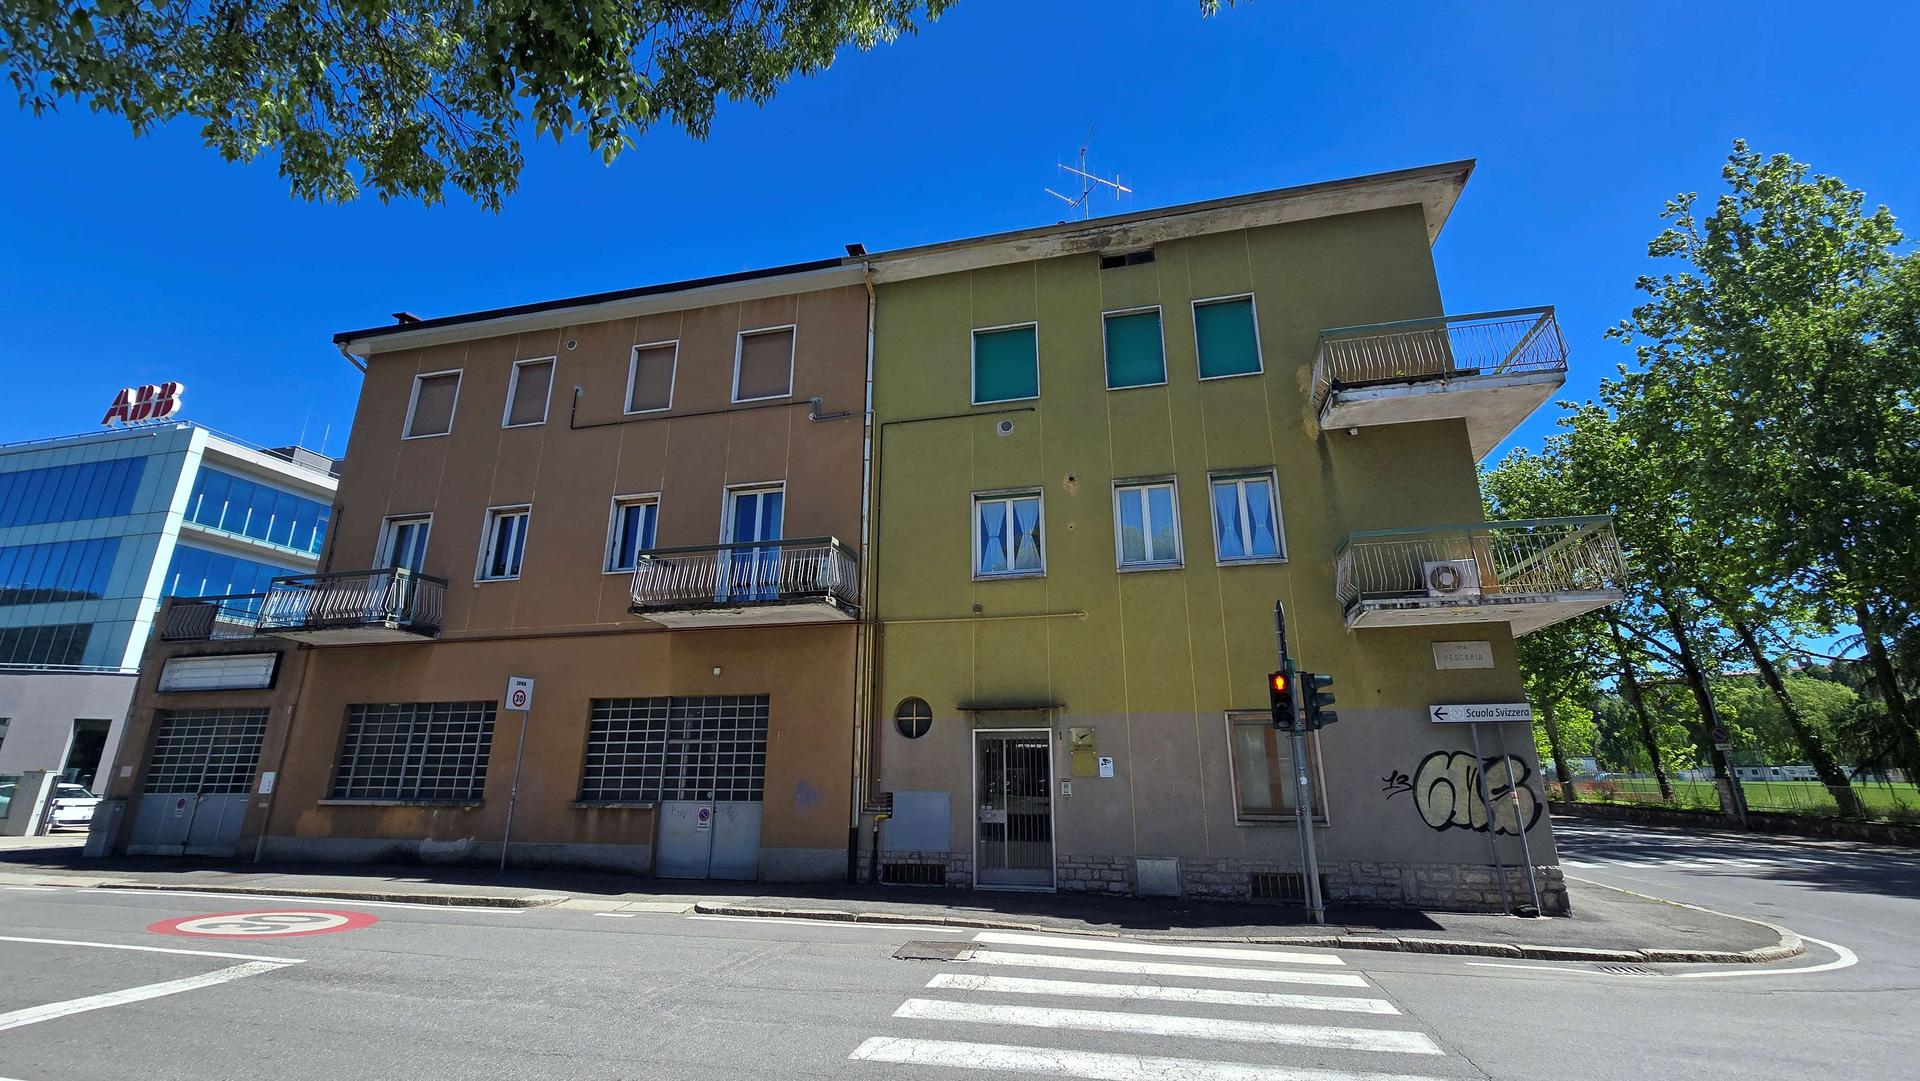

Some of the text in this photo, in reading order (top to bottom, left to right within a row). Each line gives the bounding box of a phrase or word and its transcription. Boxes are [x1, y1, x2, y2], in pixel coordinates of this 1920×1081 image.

[101, 381, 183, 425] ABB
[1466, 707, 1530, 718] Scuola Svizzera
[196, 914, 332, 932] 30
